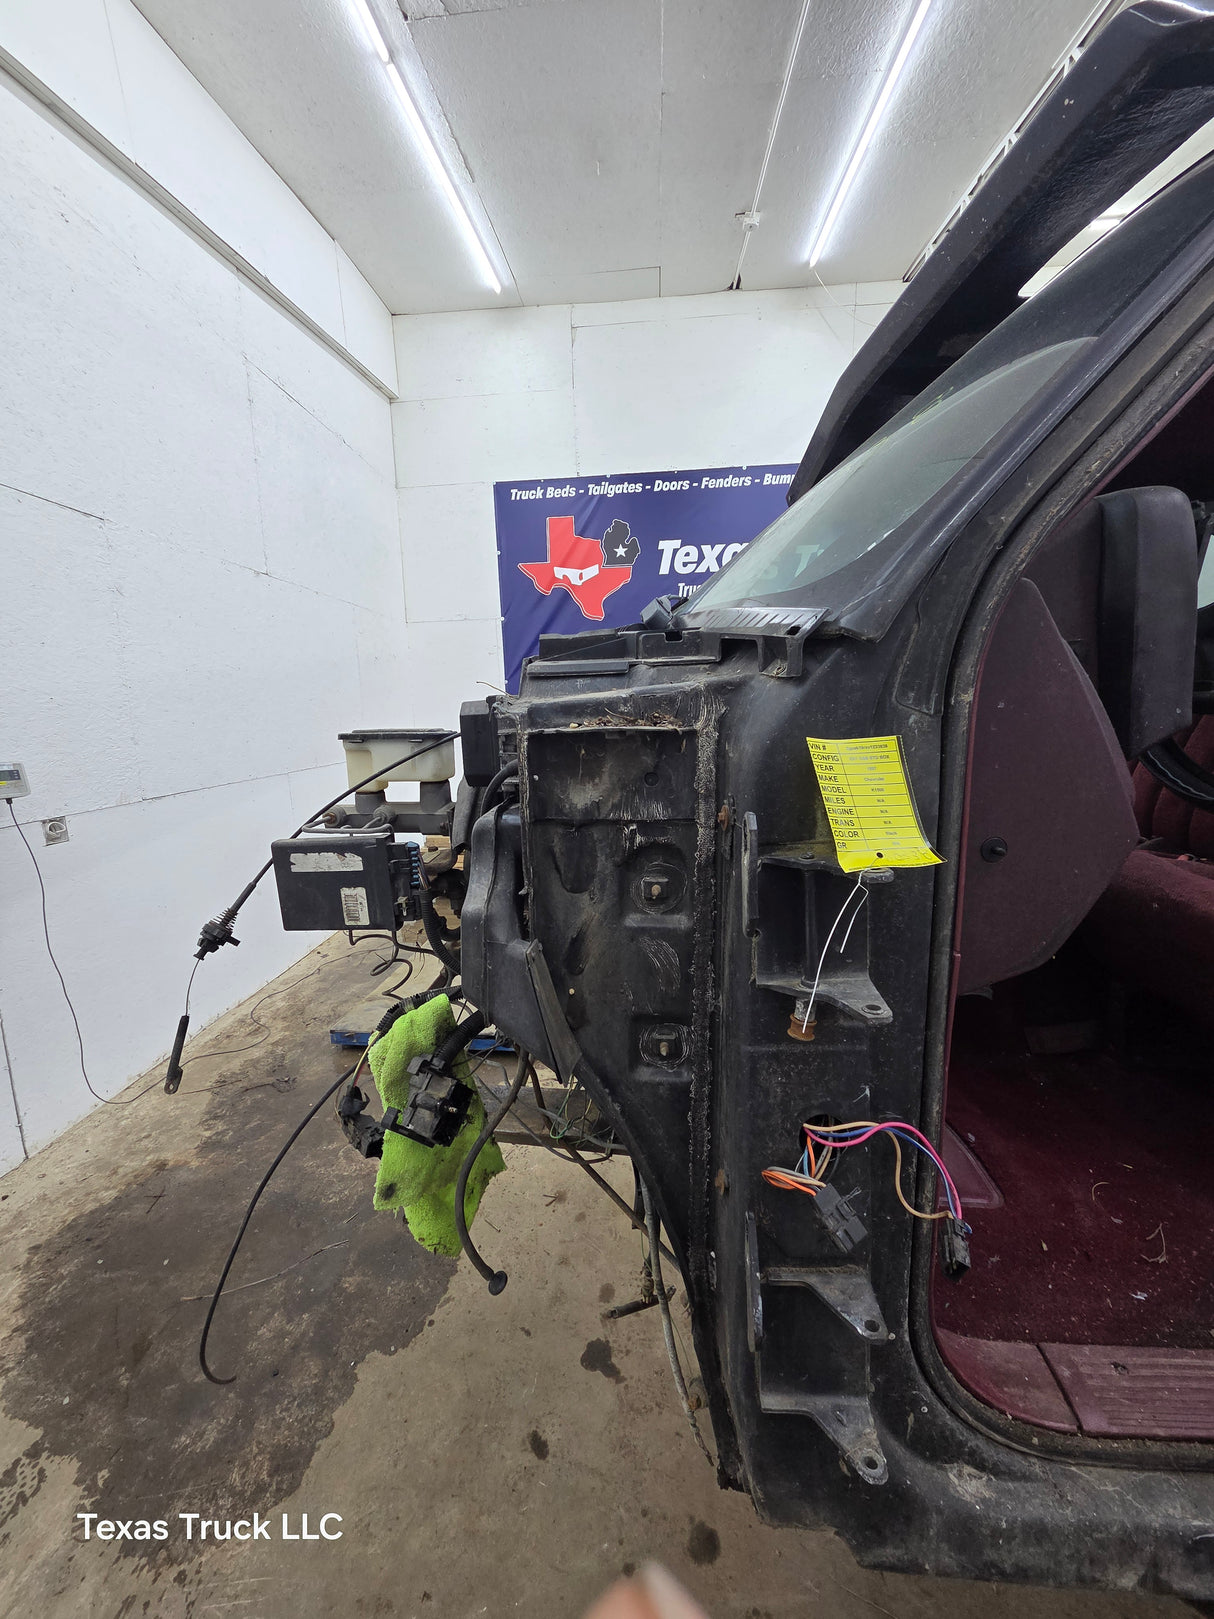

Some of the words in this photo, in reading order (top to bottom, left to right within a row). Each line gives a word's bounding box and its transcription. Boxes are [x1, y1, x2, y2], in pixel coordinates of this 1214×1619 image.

[510, 486, 544, 500] Truck
[546, 485, 576, 498] Beds
[588, 481, 643, 497] Tailgates
[653, 479, 690, 492] Doors
[701, 475, 752, 489] Fenders
[809, 743, 821, 751] VIN
[812, 754, 839, 762] CONFIG
[821, 785, 847, 793] MODEL
[824, 796, 846, 804] MILES
[830, 818, 854, 827] TRANS
[834, 830, 860, 838] COLOR
